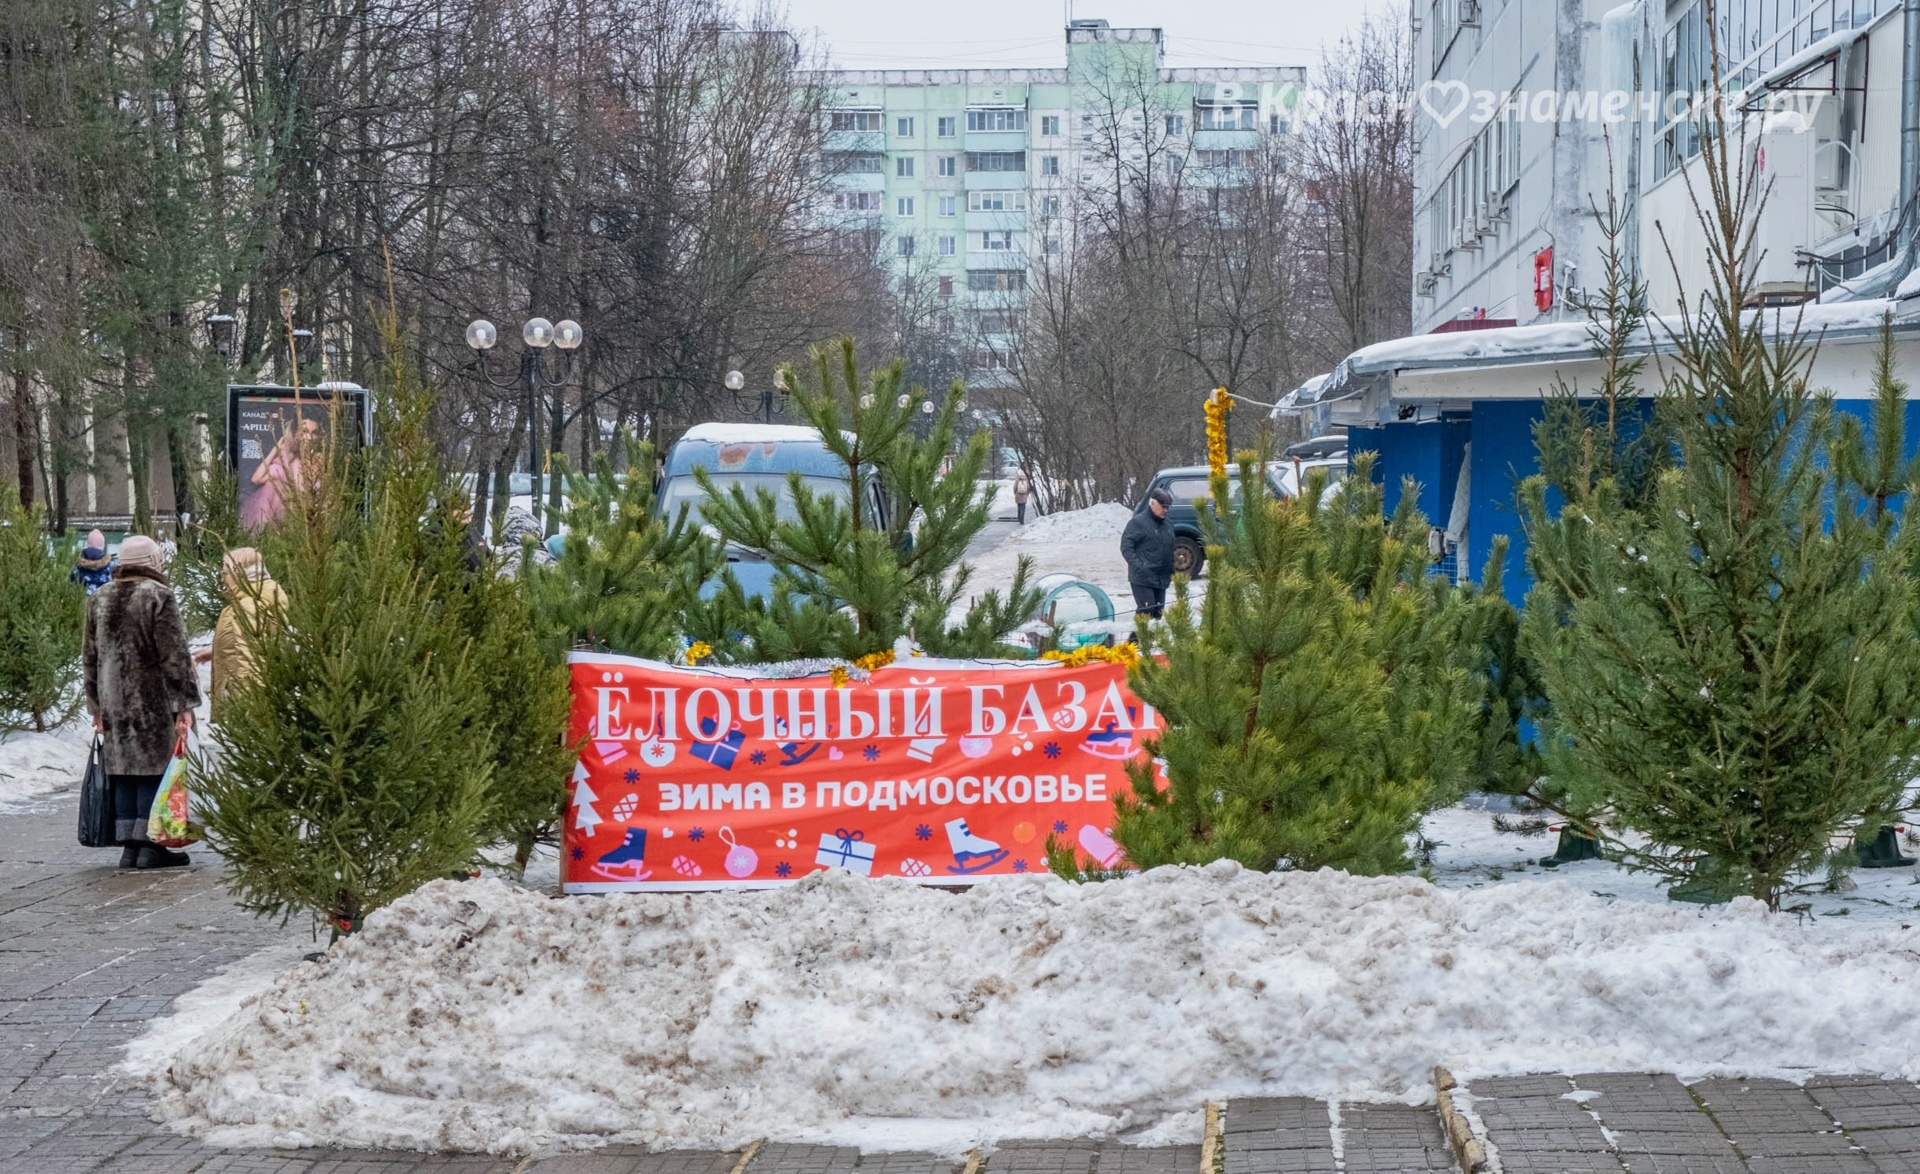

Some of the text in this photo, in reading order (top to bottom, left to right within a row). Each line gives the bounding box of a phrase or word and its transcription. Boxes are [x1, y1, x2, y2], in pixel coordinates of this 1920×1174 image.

[242, 411, 270, 419] КАНАД
[592, 671, 947, 742] ЁЛОЧНЫЙ
[658, 773, 1108, 812] ЗИМА В ПОДМОСКОВЬЕ
